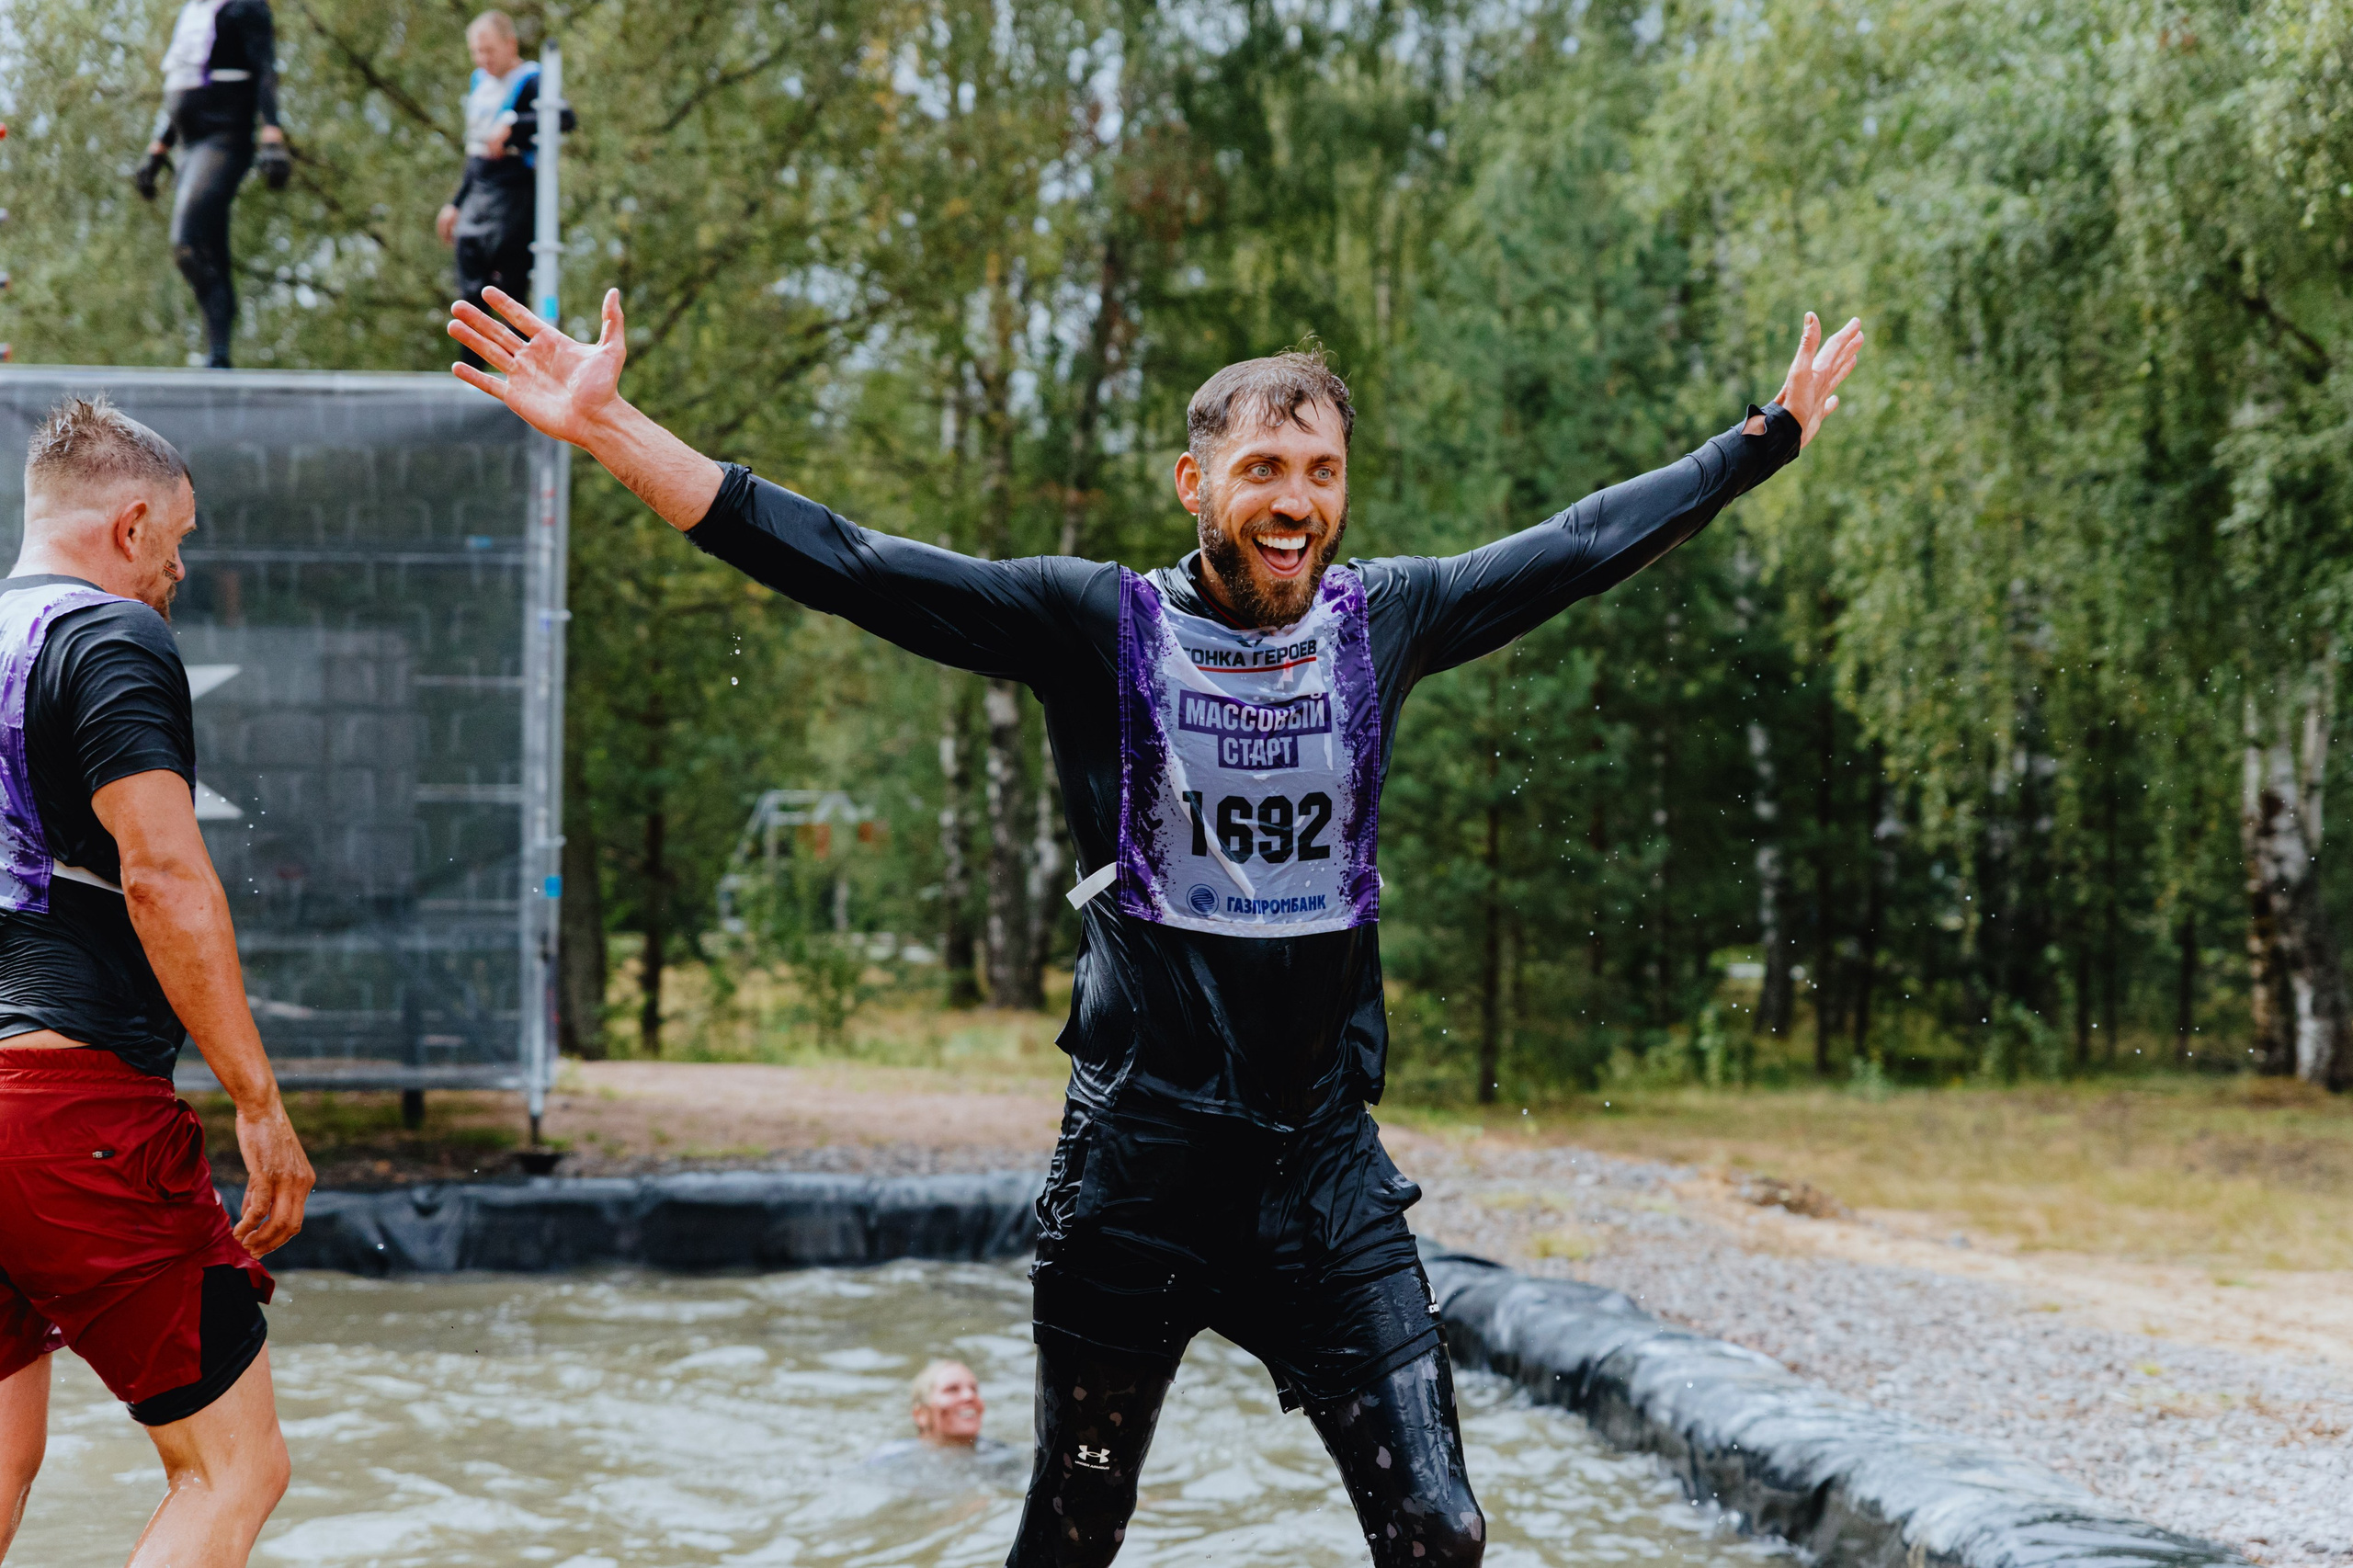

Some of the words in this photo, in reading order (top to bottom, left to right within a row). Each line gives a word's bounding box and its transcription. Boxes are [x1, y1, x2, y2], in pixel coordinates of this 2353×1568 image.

[1253, 639, 1317, 665] ГЕРОЕВ
[1186, 692, 1325, 732] МАССОВЫЙ
[1222, 736, 1292, 767] СТАРТ
[1182, 790, 1332, 864] 1692
[1227, 894, 1326, 915] ГАЗПРОМБАНК
